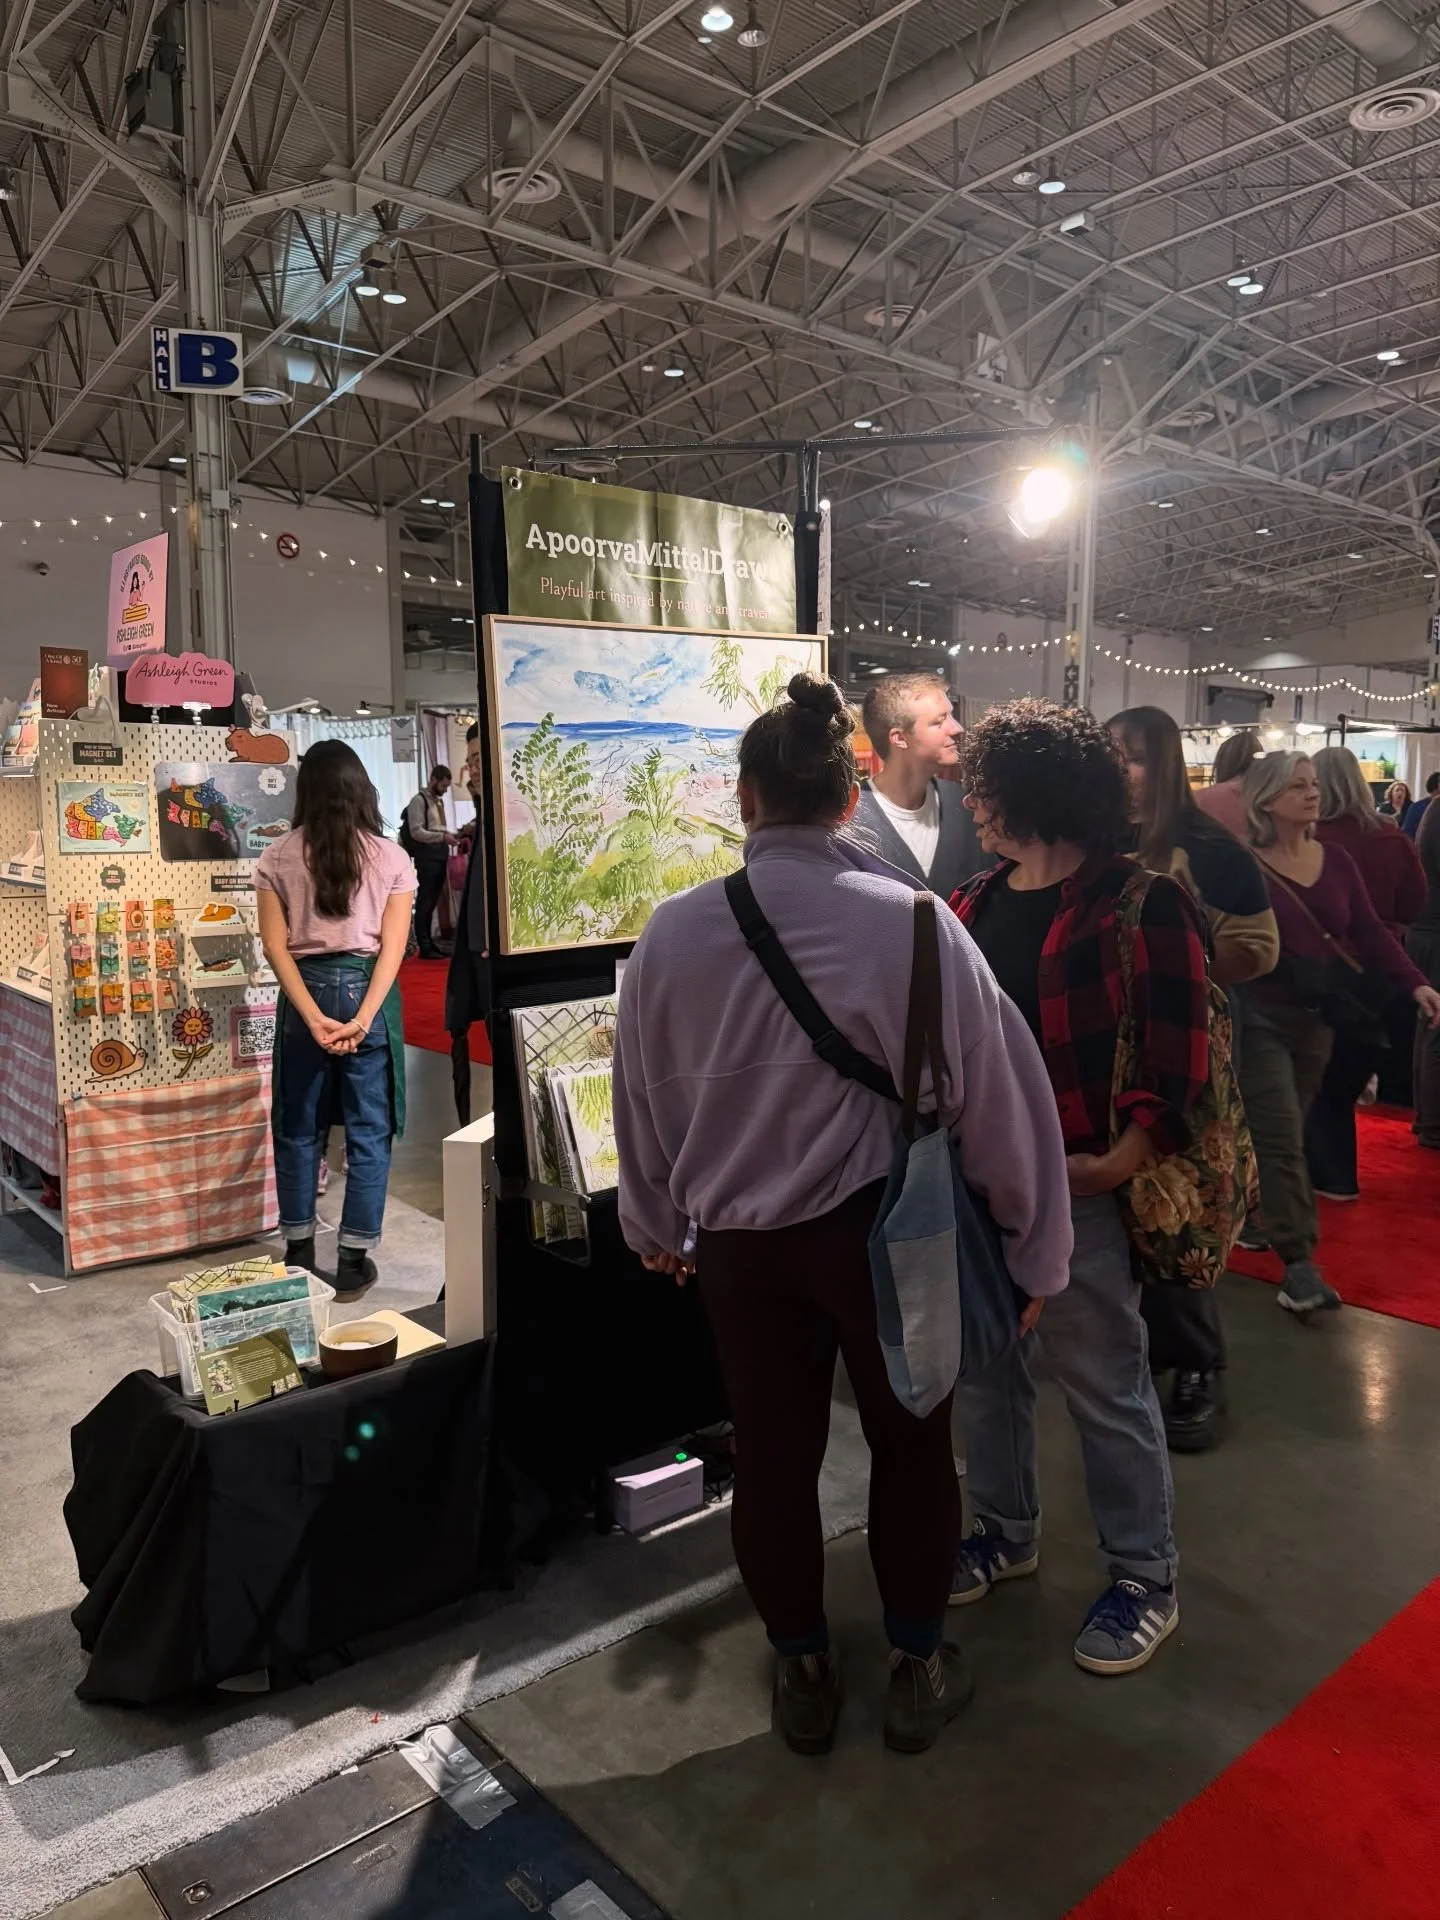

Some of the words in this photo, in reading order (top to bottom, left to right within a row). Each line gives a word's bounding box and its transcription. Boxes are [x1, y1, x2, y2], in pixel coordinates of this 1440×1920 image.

[155, 330, 169, 389] HALL
[174, 333, 240, 389] B
[541, 577, 583, 600] Playful
[588, 589, 605, 601] art
[659, 592, 673, 613] by
[139, 622, 154, 639] GREEN
[136, 661, 190, 685] Ashleigh
[193, 662, 228, 677] Green
[80, 750, 104, 758] MAGNET
[105, 750, 116, 758] SET
